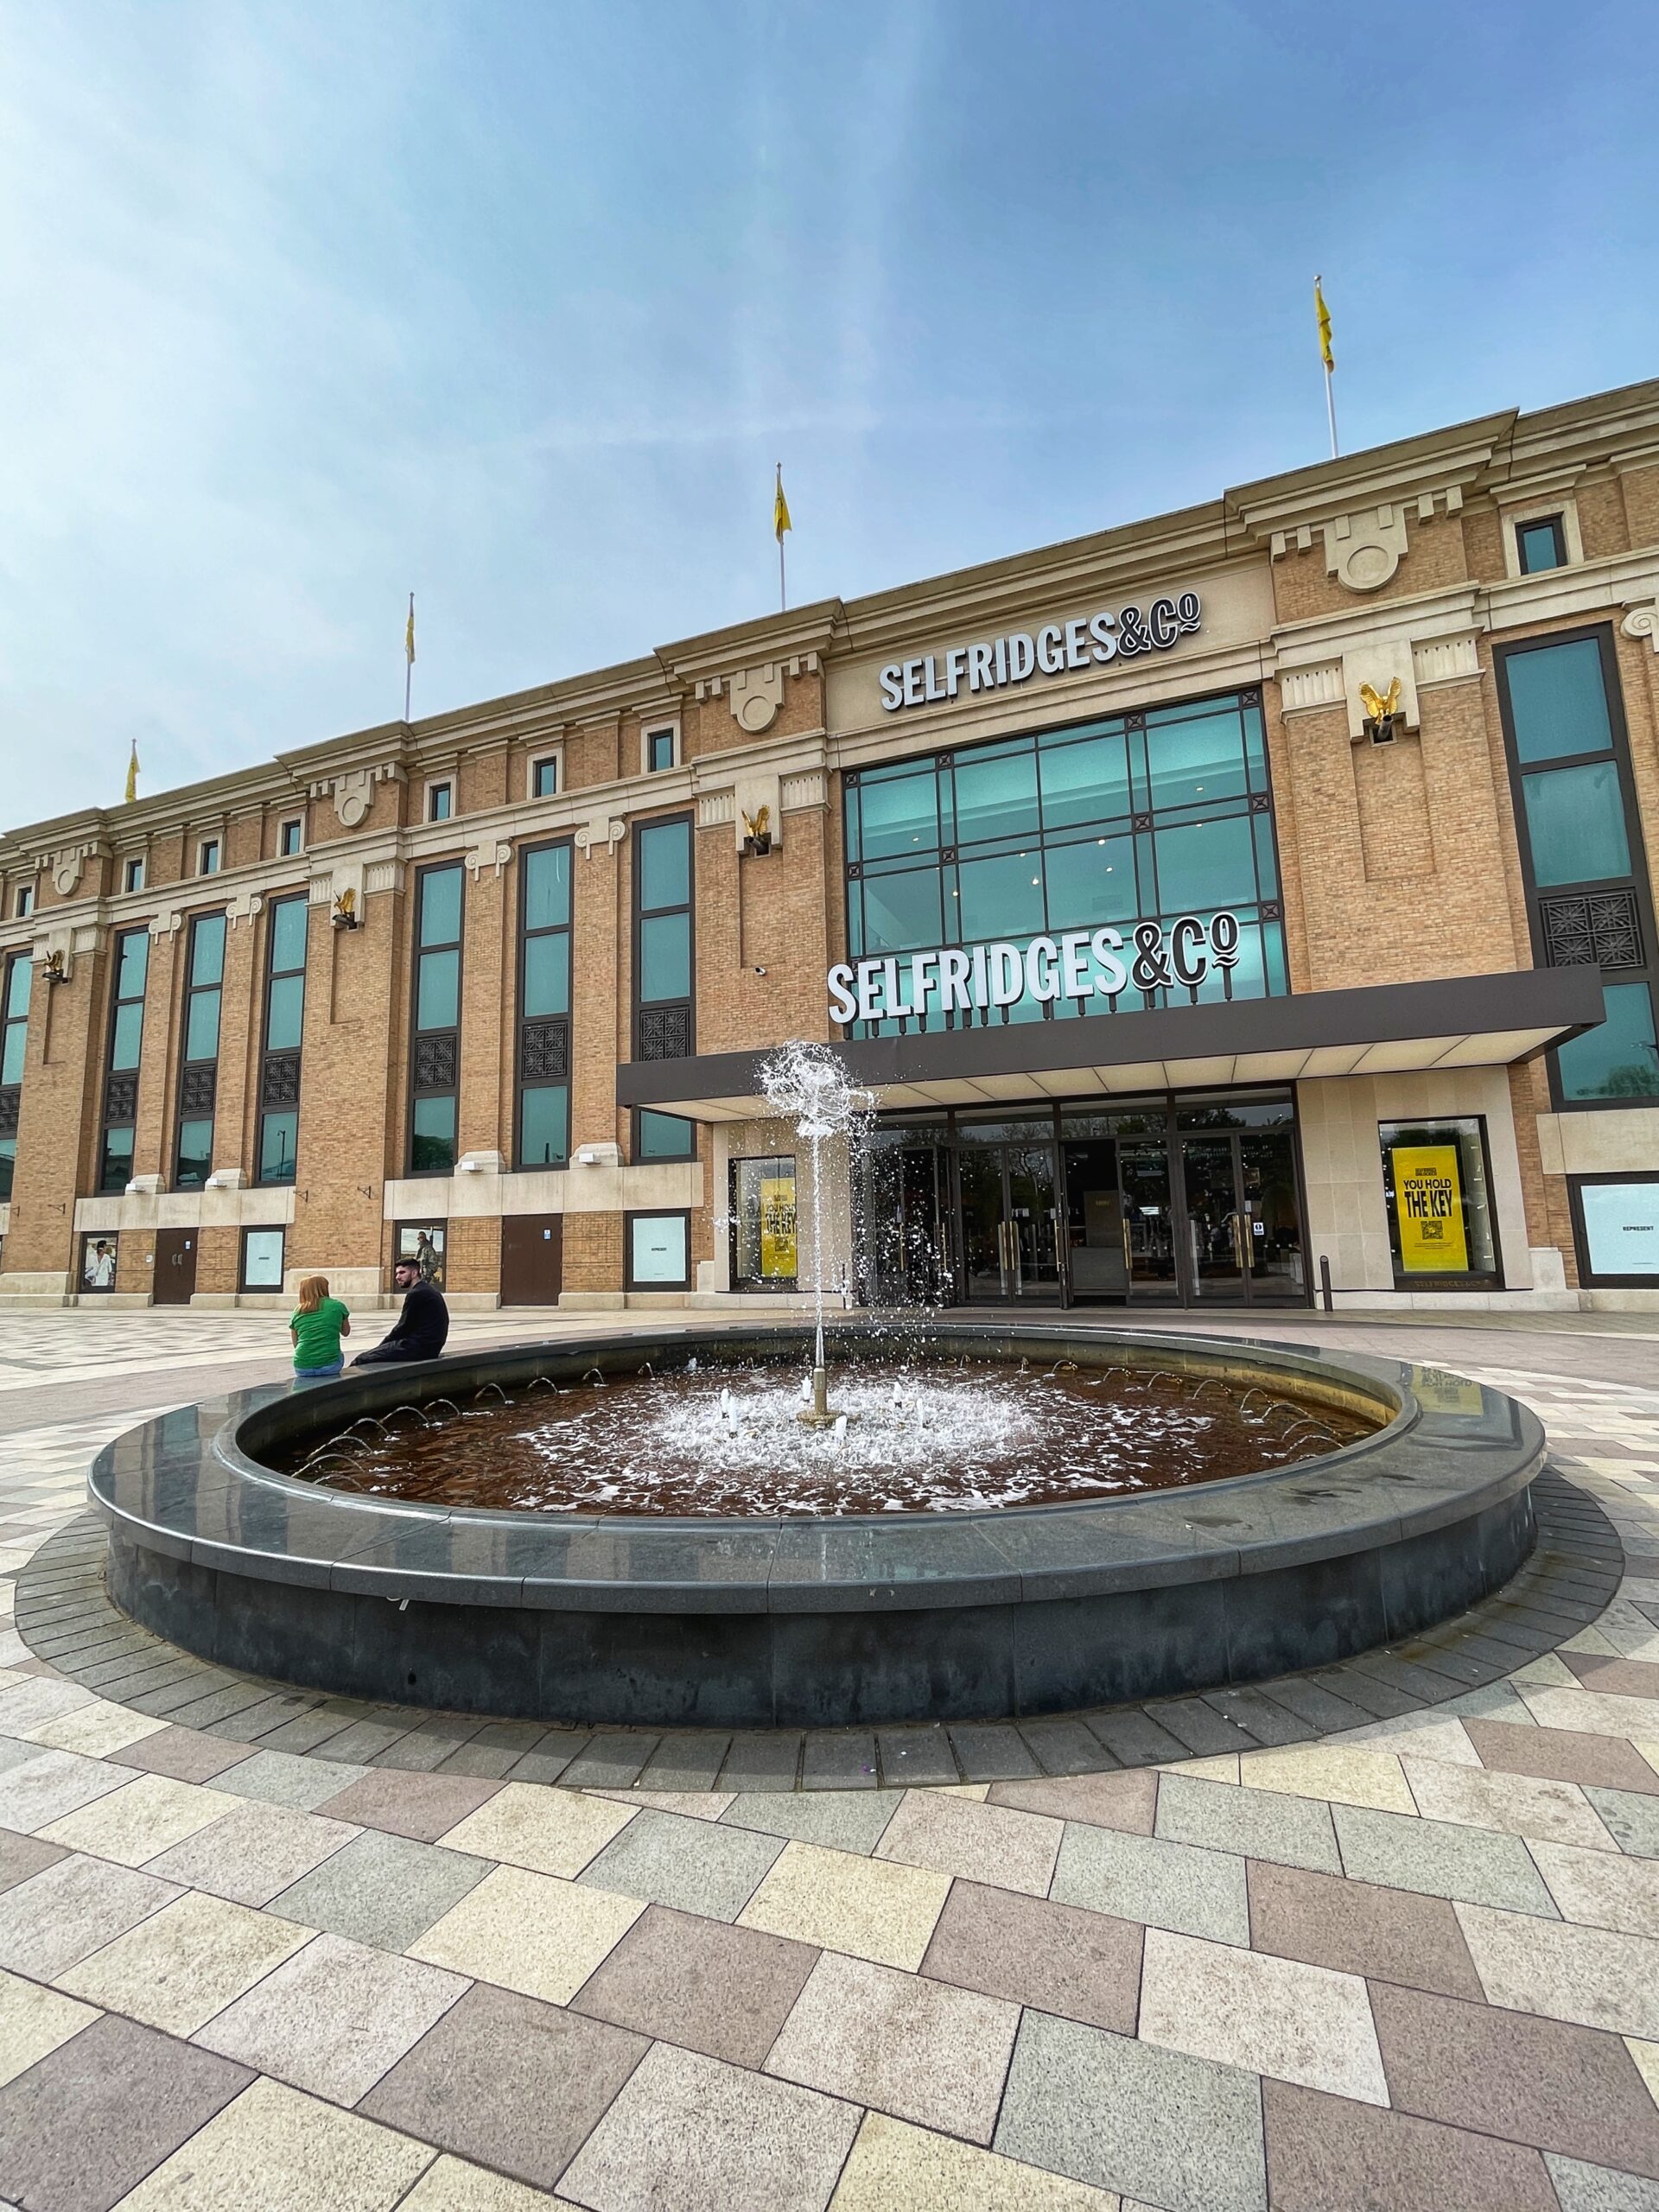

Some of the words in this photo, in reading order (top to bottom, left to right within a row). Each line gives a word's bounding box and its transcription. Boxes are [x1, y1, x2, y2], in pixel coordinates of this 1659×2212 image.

[1403, 1179, 1423, 1190] YOU
[1425, 1179, 1452, 1189] HOLD
[1404, 1190, 1428, 1217] THE
[1430, 1190, 1452, 1217] KEY
